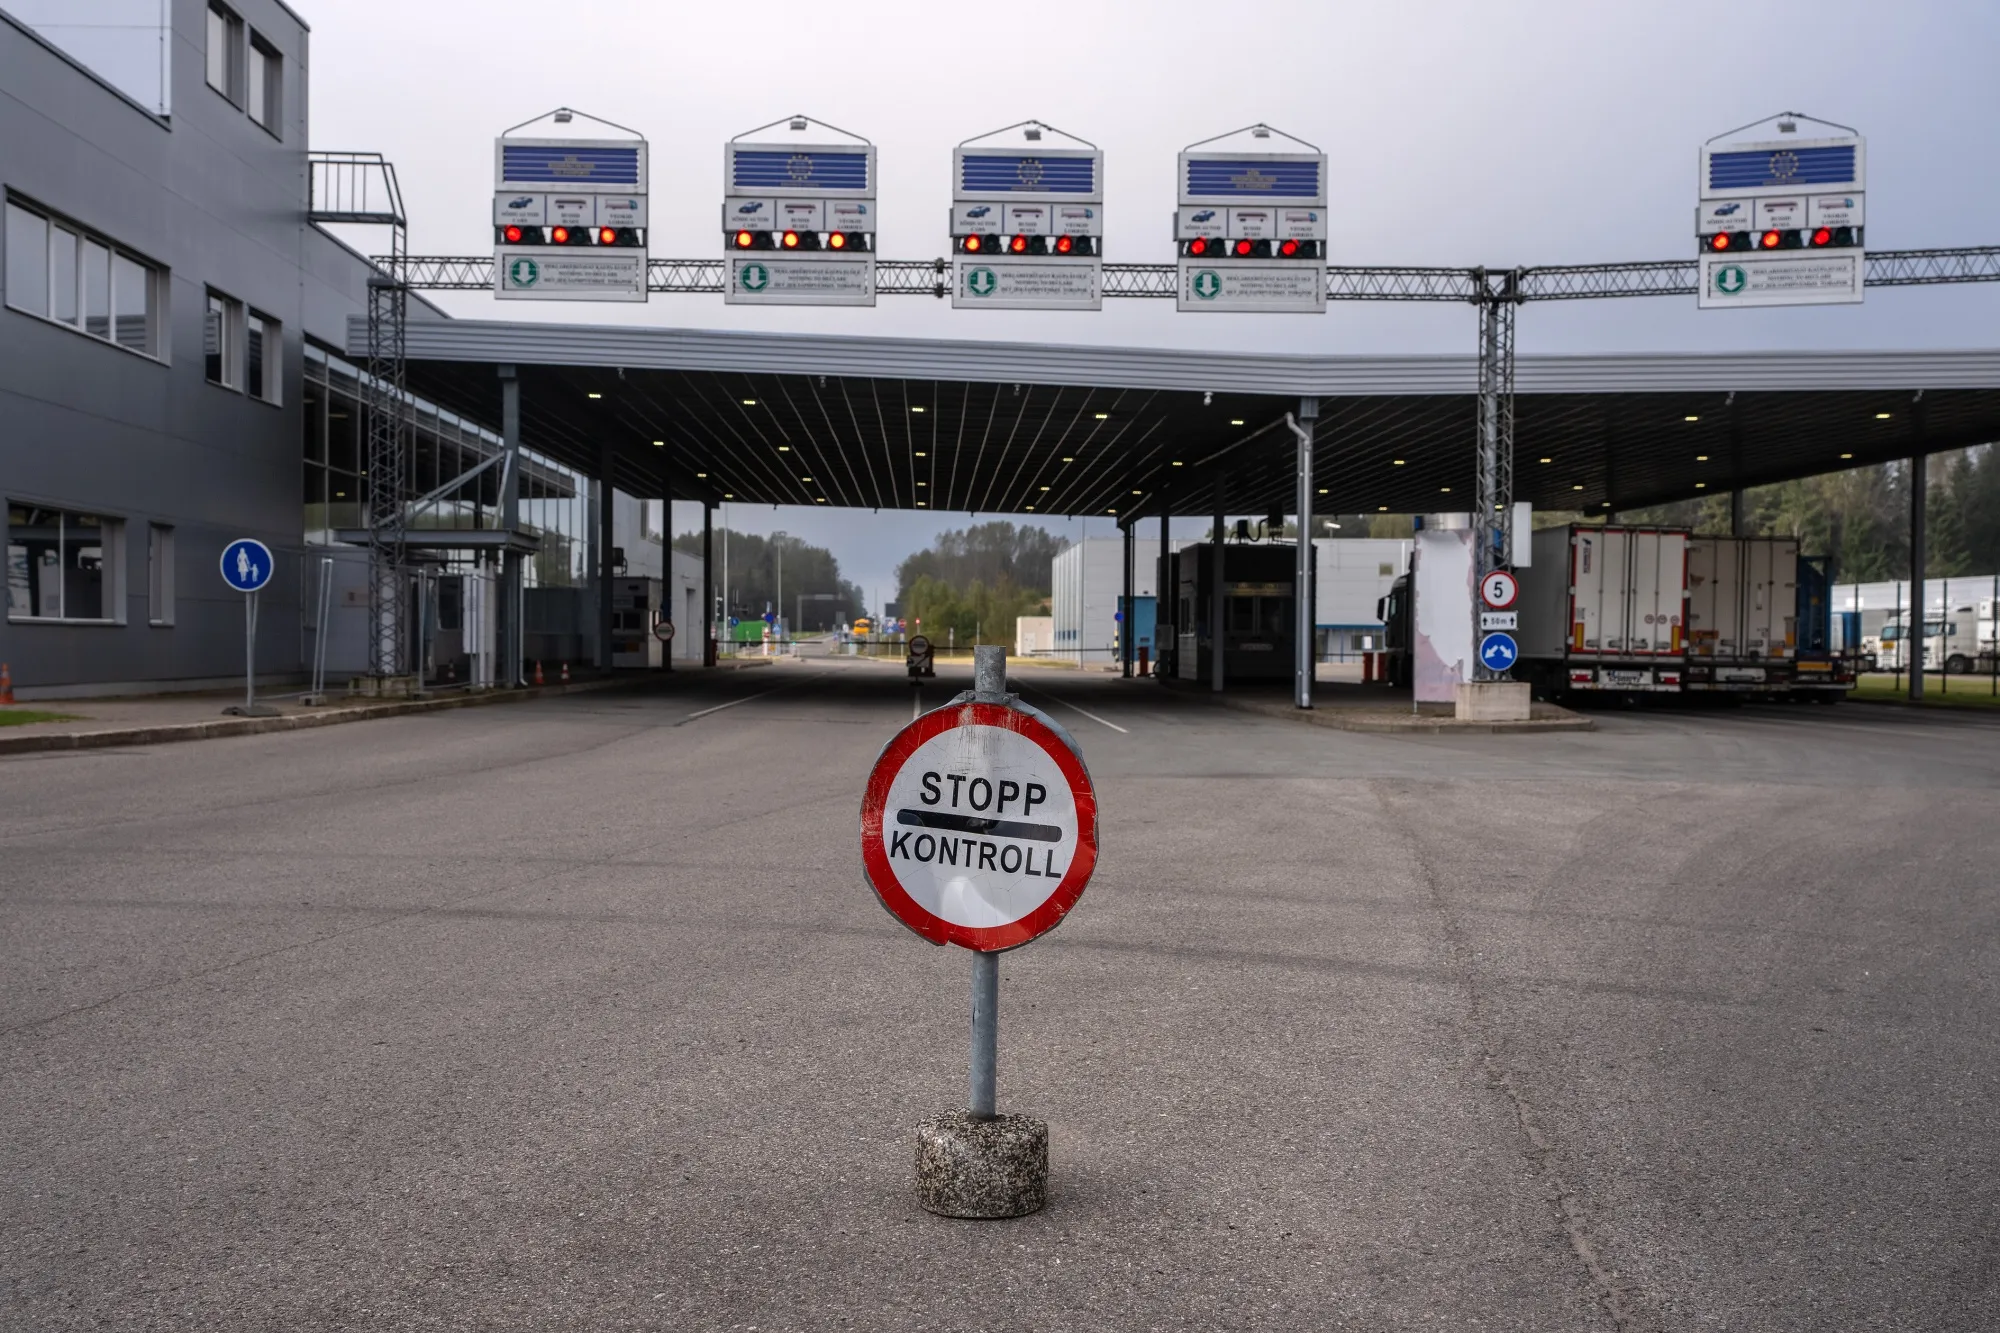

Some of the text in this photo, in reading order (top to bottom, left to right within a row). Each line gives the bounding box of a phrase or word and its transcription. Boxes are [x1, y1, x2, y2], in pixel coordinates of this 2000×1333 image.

[1493, 582, 1503, 598] 5
[920, 771, 1047, 816] STOPP
[890, 830, 1062, 879] KONTROLL
